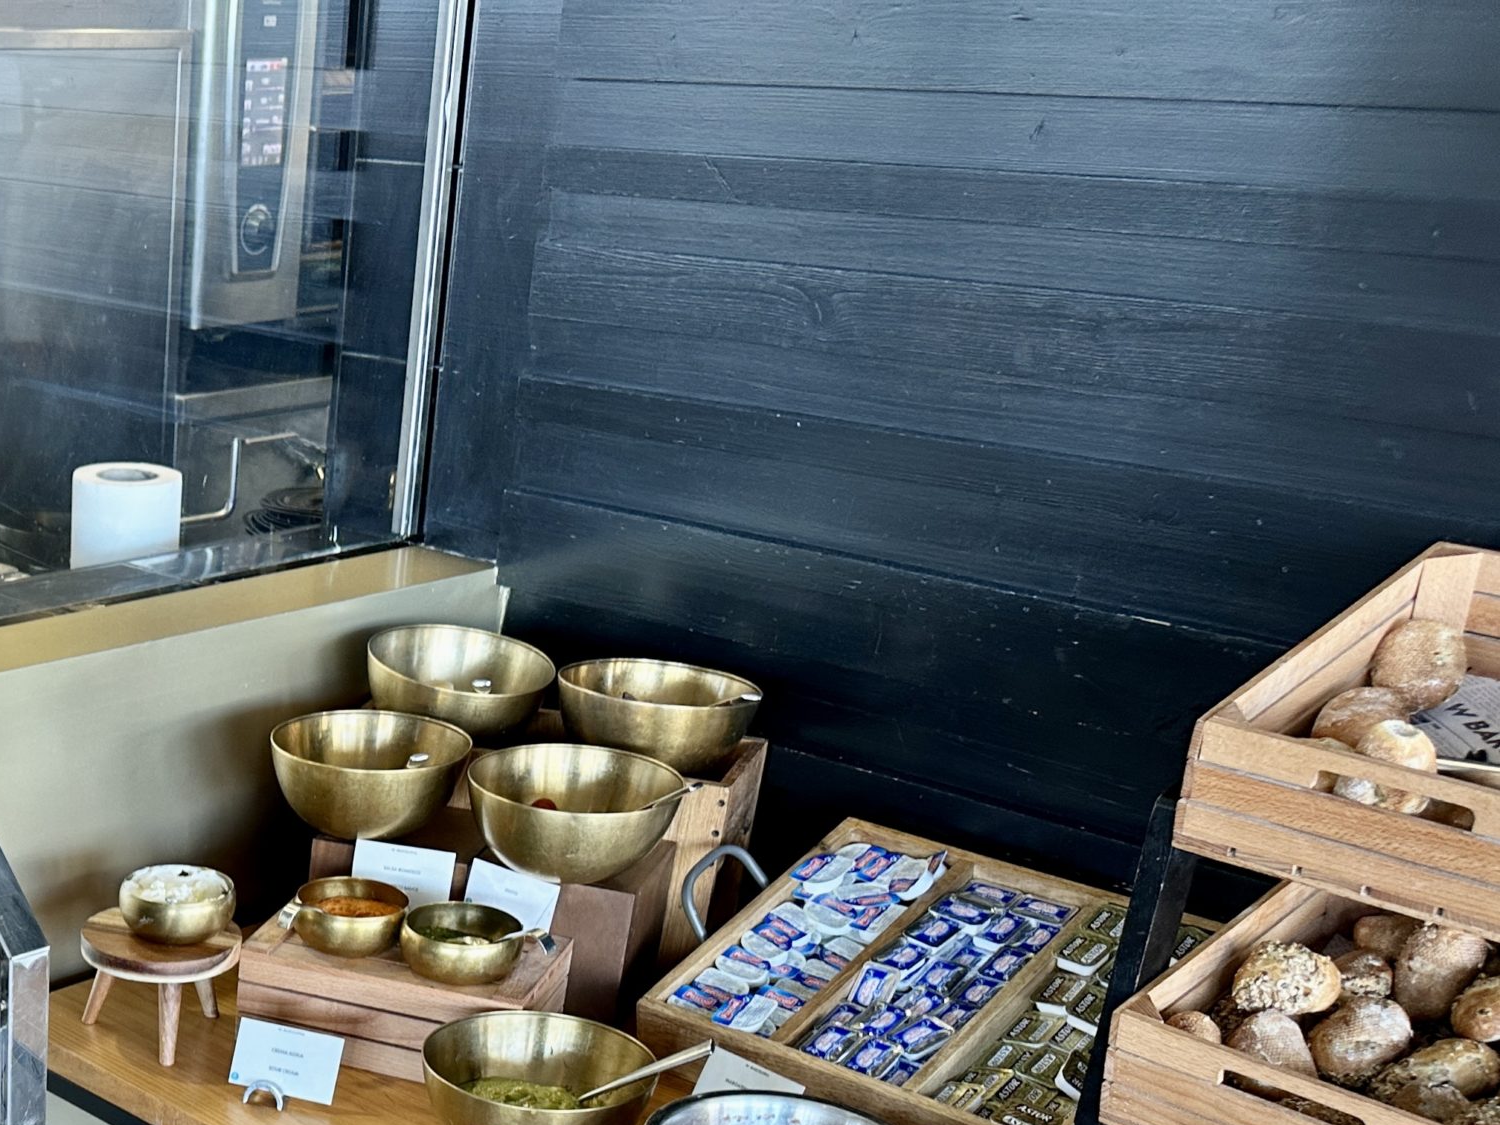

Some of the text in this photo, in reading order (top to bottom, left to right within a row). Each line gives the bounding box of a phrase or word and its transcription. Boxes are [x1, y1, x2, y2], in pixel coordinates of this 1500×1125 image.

[1444, 703, 1478, 717] W
[1090, 911, 1111, 930] ASTOR
[1063, 937, 1085, 956] ASTOR
[1175, 936, 1195, 957] ASTOR
[1043, 977, 1064, 998] ASTOR
[1075, 994, 1096, 1014] ASTOR
[1010, 1018, 1030, 1037] ASTOR
[999, 1079, 1020, 1100] ASTOR
[1017, 1105, 1052, 1122] ASTOR
